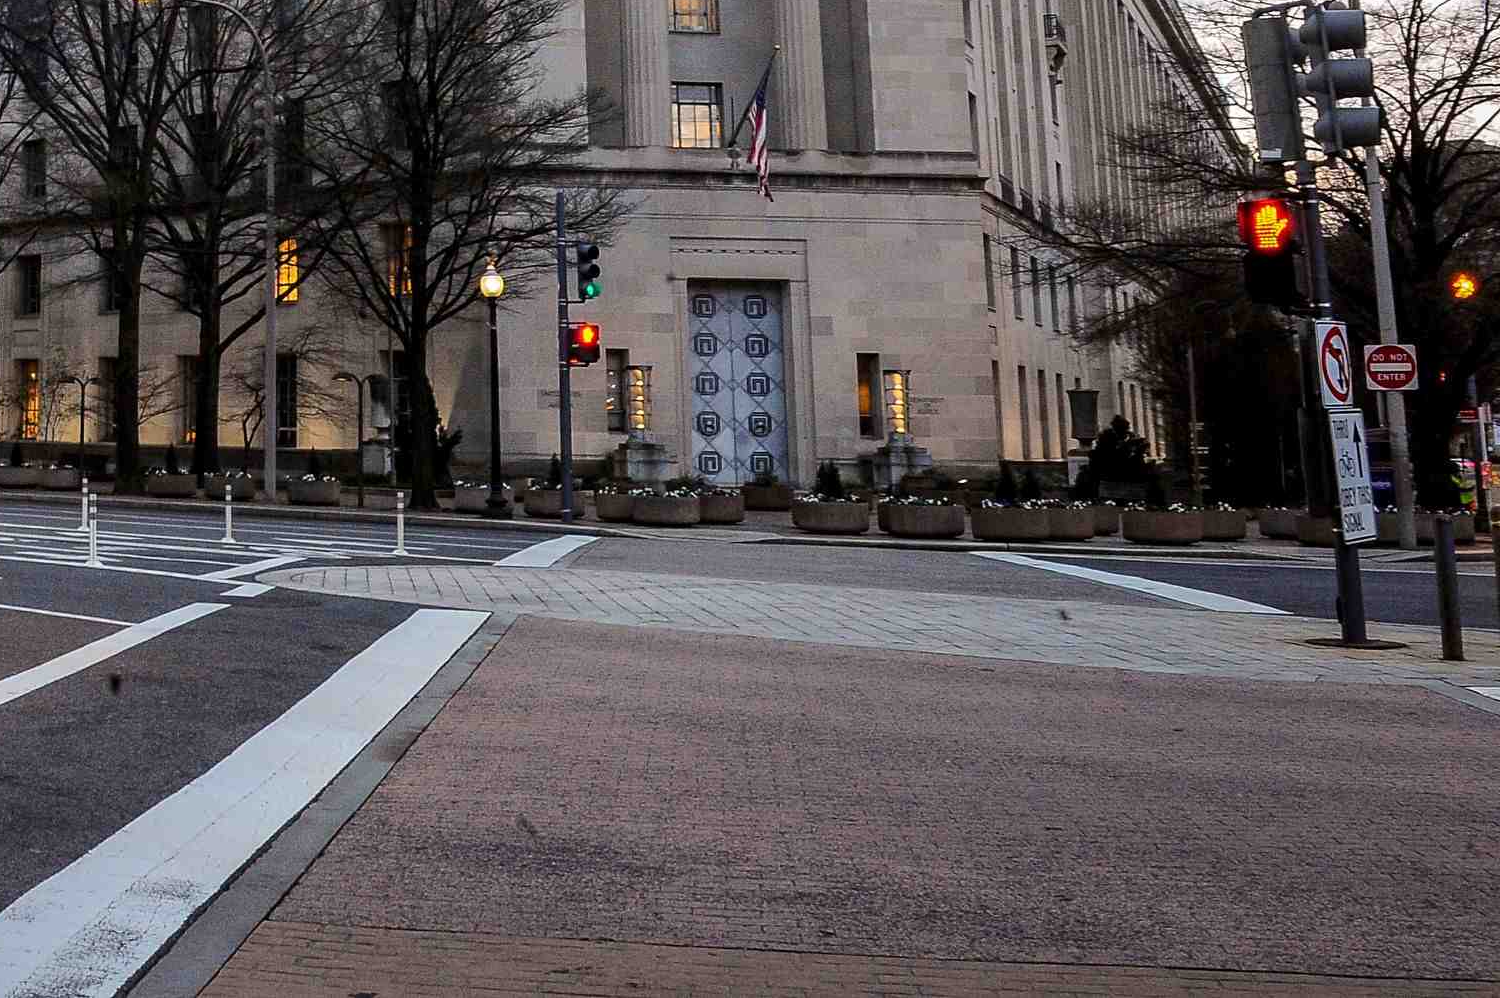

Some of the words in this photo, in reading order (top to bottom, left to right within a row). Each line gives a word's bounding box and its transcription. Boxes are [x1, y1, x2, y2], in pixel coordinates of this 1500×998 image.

[1372, 353, 1384, 362] DO
[1390, 353, 1407, 362] NOT
[1378, 373, 1405, 381] ENTER
